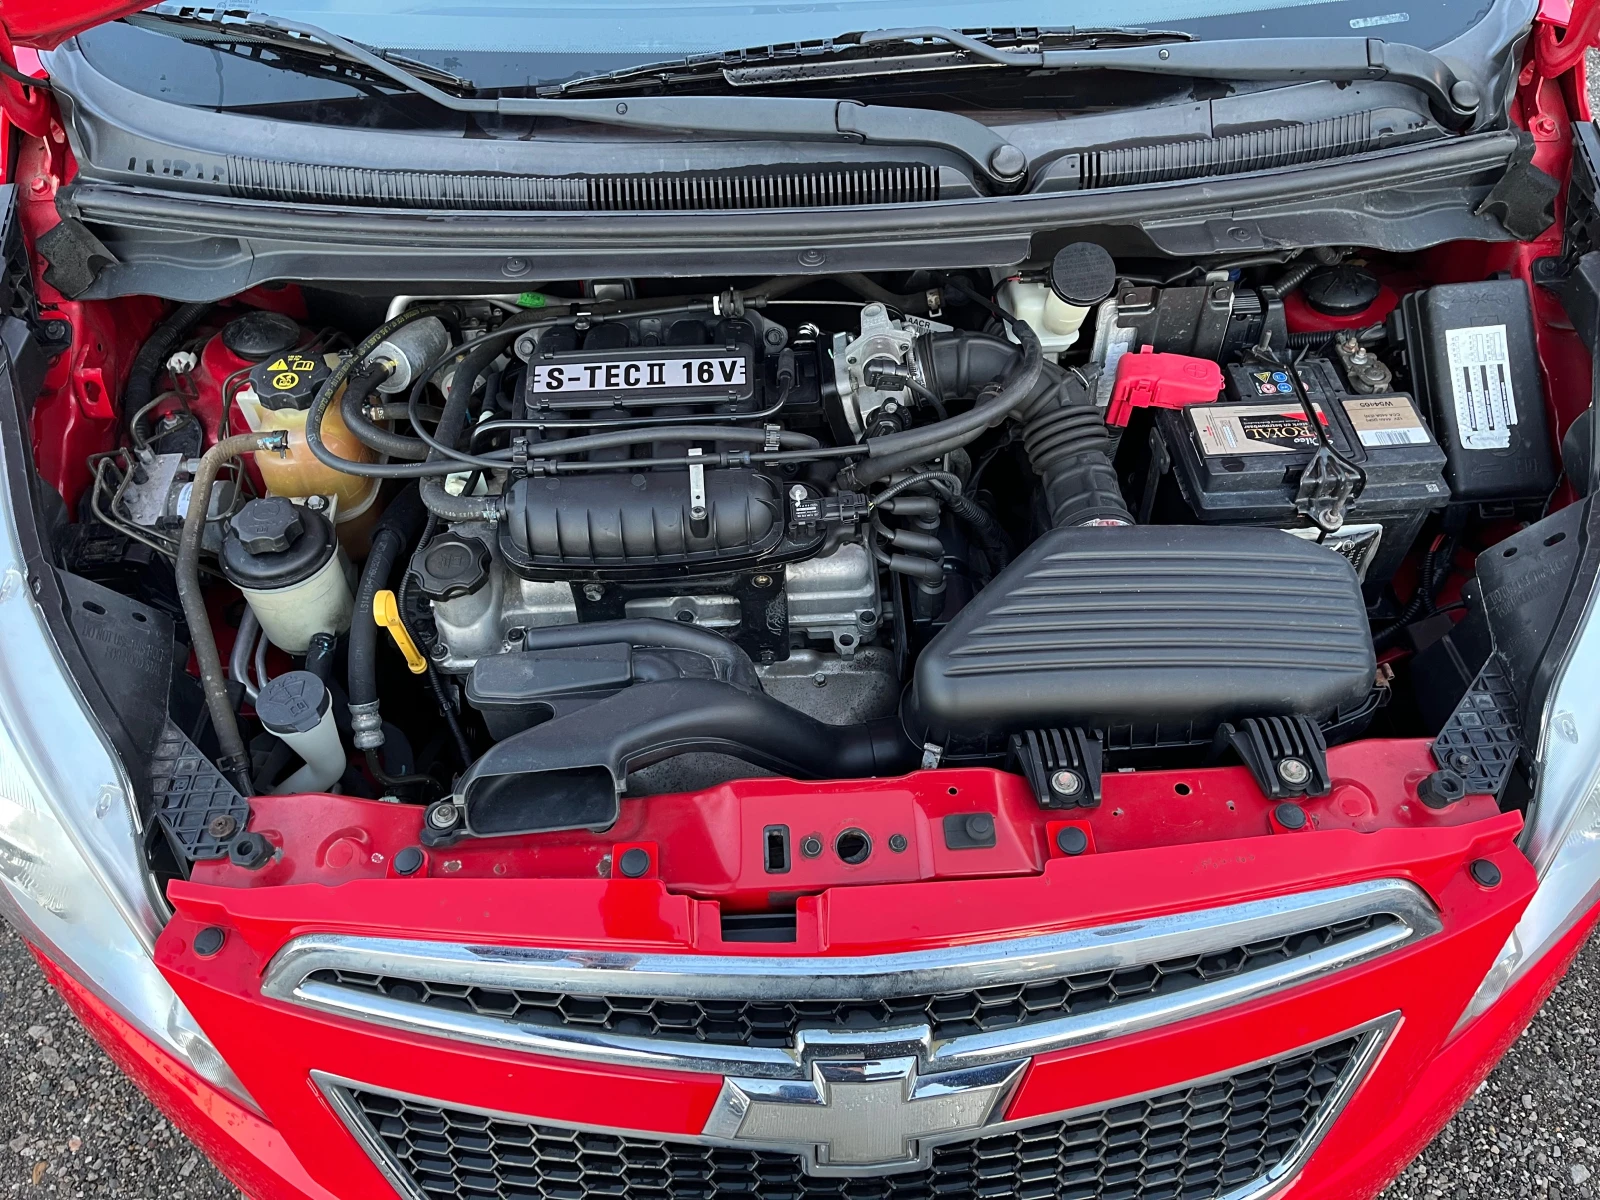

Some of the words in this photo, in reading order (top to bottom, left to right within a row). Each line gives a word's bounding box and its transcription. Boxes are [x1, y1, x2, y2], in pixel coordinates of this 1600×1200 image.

[908, 317, 931, 329] AACR
[682, 360, 738, 384] 16V
[1245, 425, 1313, 439] ROYAL
